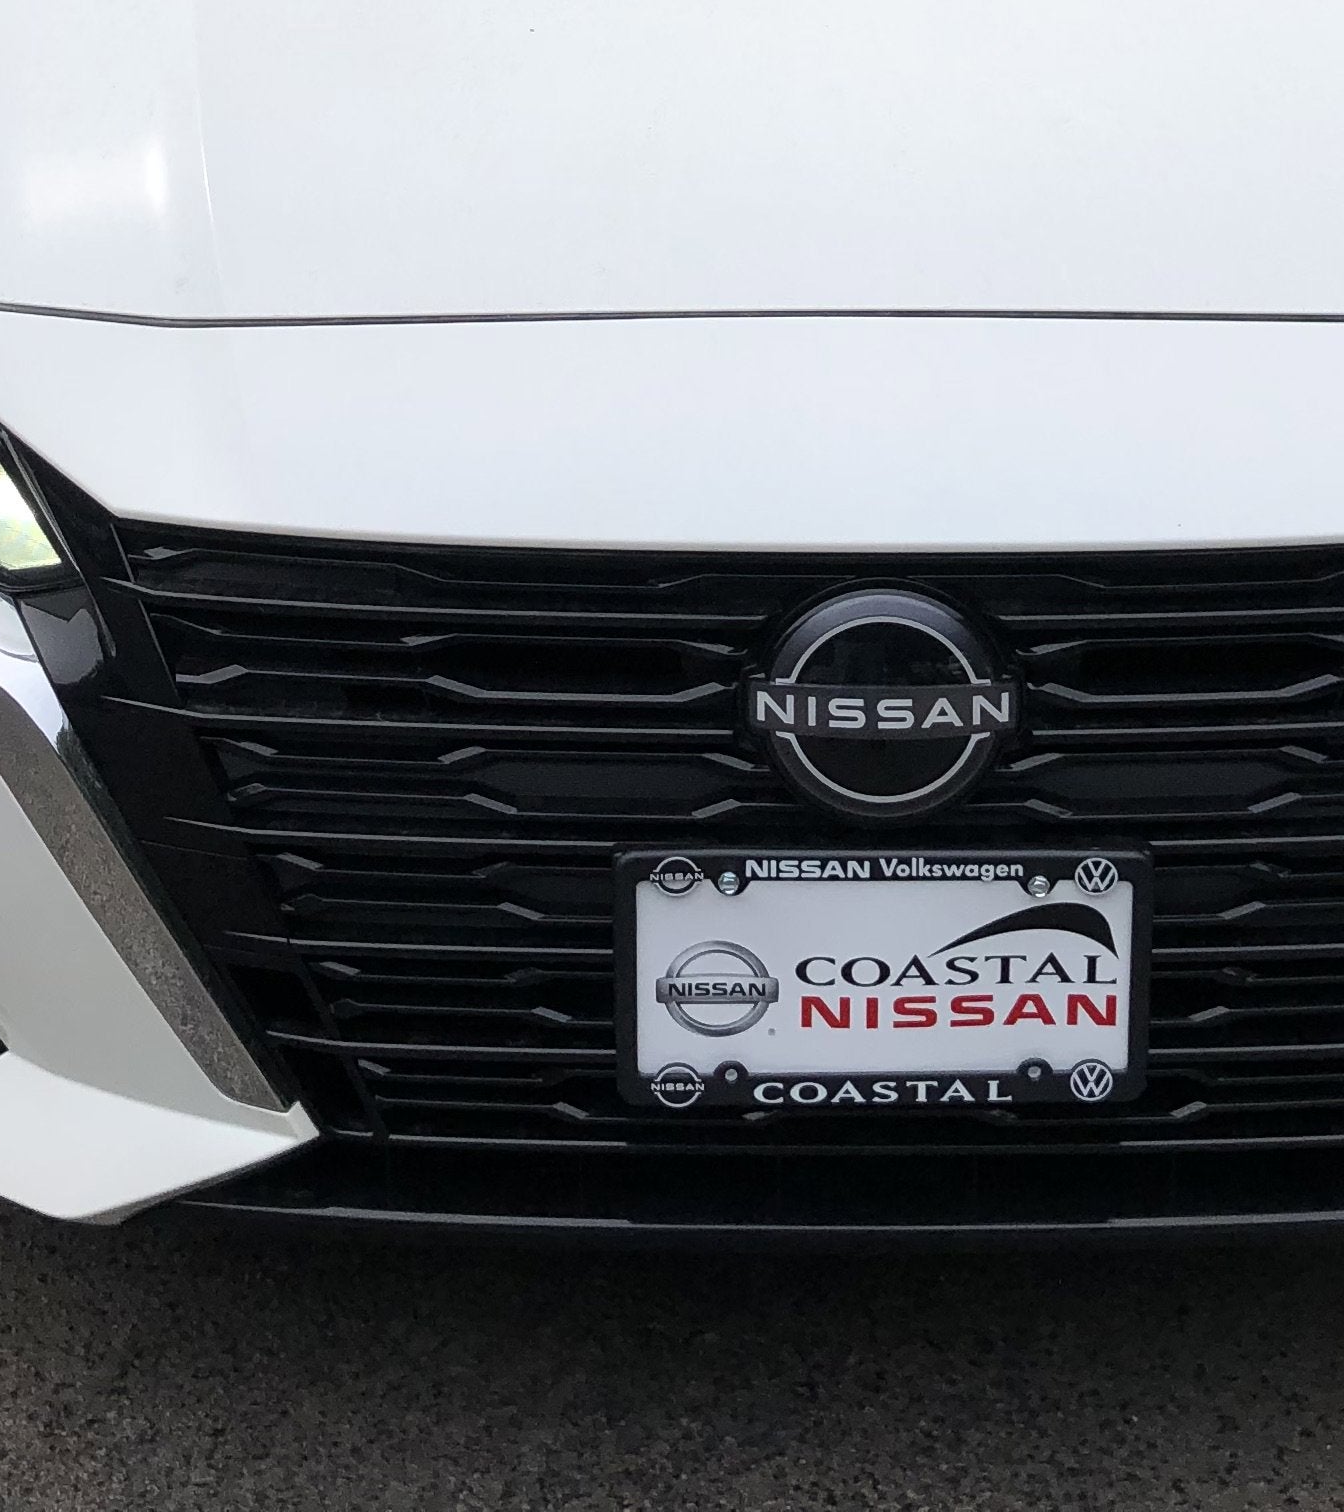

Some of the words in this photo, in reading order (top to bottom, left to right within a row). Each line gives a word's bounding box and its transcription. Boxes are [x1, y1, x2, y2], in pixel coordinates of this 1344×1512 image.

[756, 690, 1009, 730] NISSAN
[649, 871, 704, 882] NISSAN
[745, 859, 871, 879] NISSAN
[878, 857, 1024, 882] Volkswagen
[794, 951, 1118, 987] COASTAL
[668, 982, 766, 997] NISSAN
[801, 993, 1117, 1029] NISSAN
[650, 1082, 705, 1091] NISSAN
[753, 1079, 1013, 1104] COASTAL
